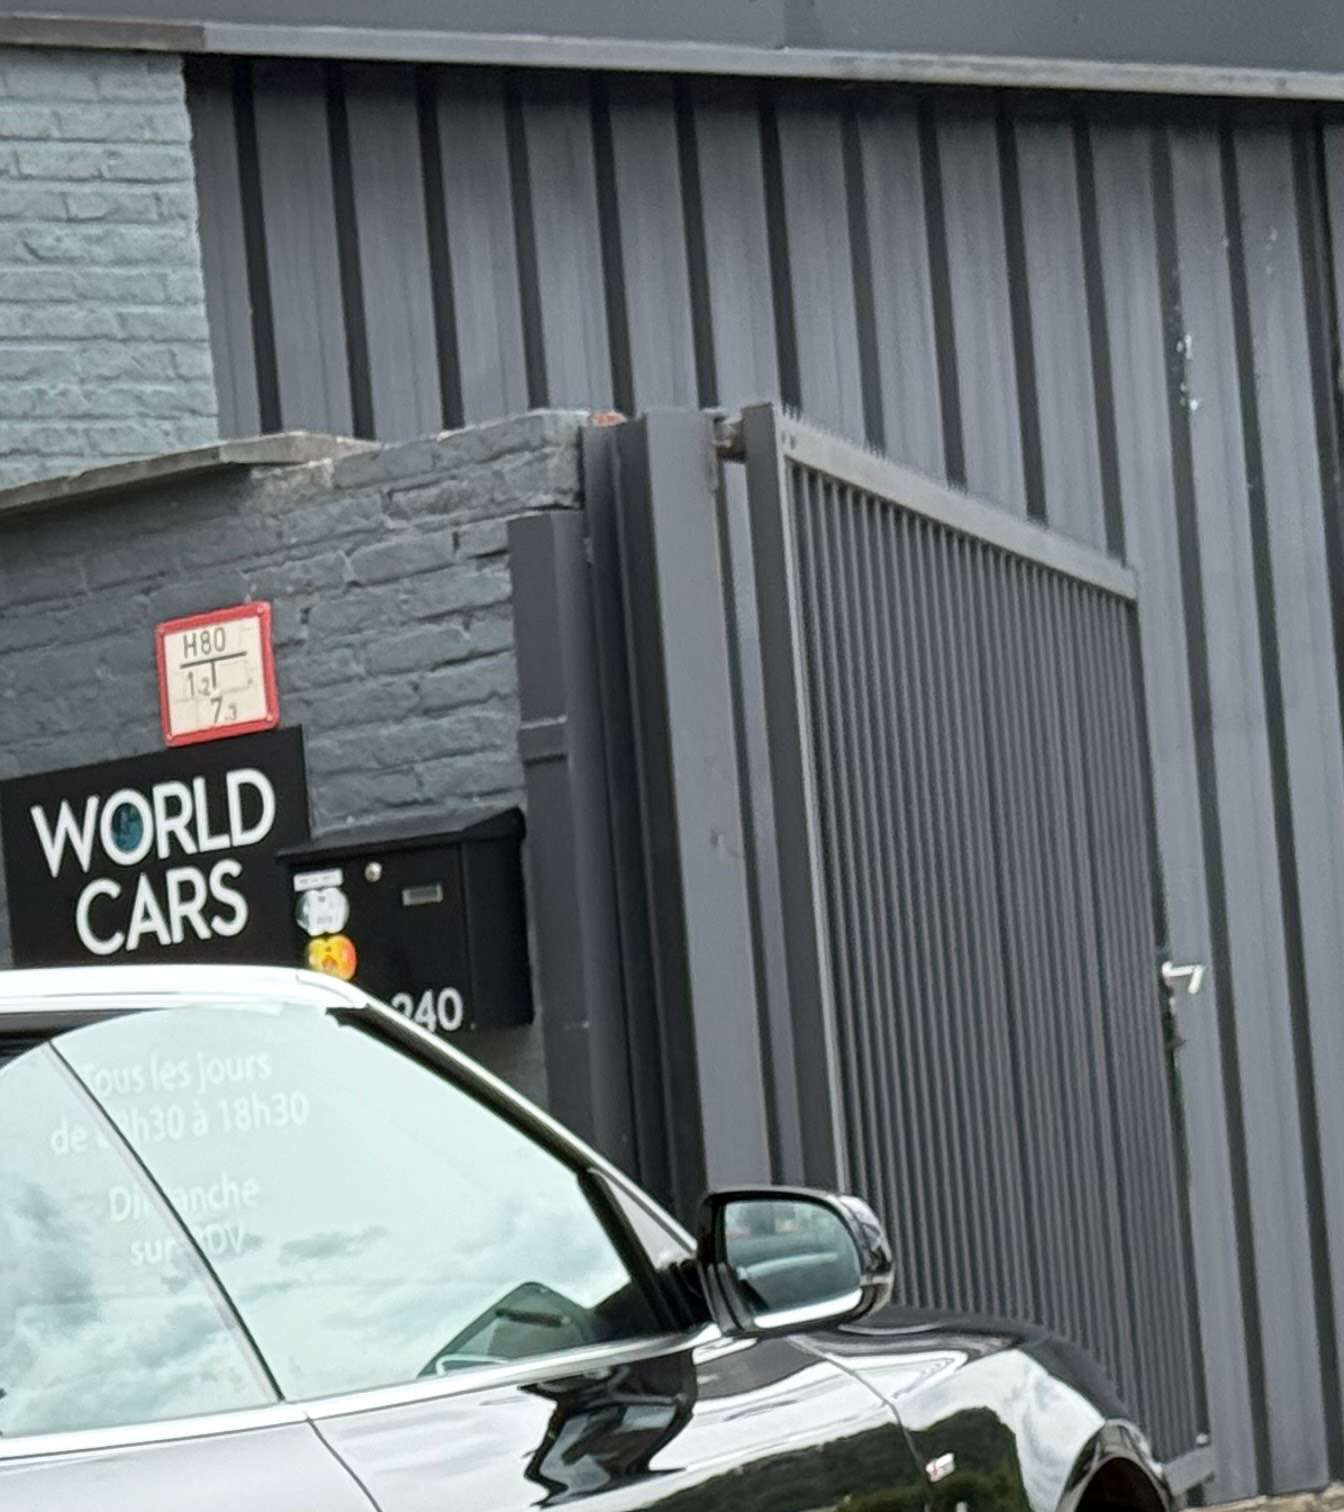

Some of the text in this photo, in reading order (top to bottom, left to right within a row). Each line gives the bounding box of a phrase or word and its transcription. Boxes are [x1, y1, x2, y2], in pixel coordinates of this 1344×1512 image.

[183, 626, 227, 660] H80
[30, 768, 277, 878] WORLD
[75, 859, 248, 955] CARS
[150, 1053, 191, 1091] les
[196, 1050, 272, 1094] jours
[50, 1115, 88, 1153] de
[218, 1090, 311, 1132] 18h30
[109, 1170, 260, 1222] Dianche
[130, 1236, 178, 1266] sur
